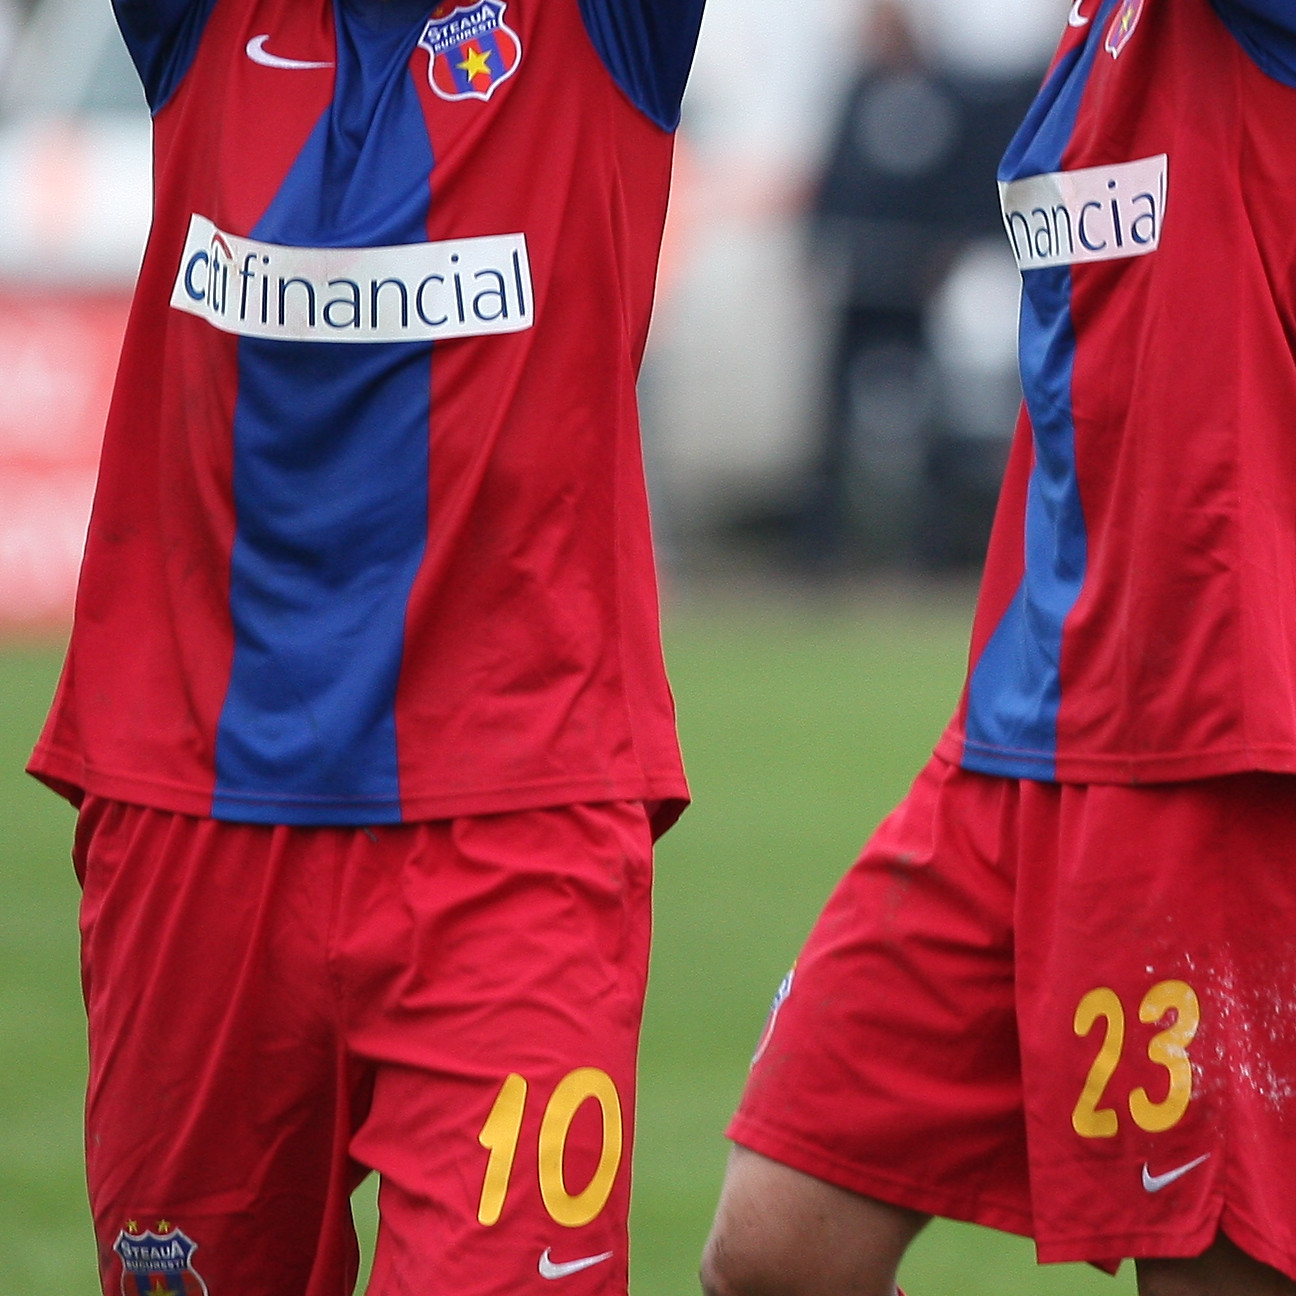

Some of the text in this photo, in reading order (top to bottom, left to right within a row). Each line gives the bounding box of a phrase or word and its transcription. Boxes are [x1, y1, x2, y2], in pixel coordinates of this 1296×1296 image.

[427, 4, 496, 43] STEAUA
[1005, 171, 1164, 261] nancial
[239, 249, 526, 329] financial
[1072, 979, 1200, 1138] 23
[476, 1066, 624, 1228] 10
